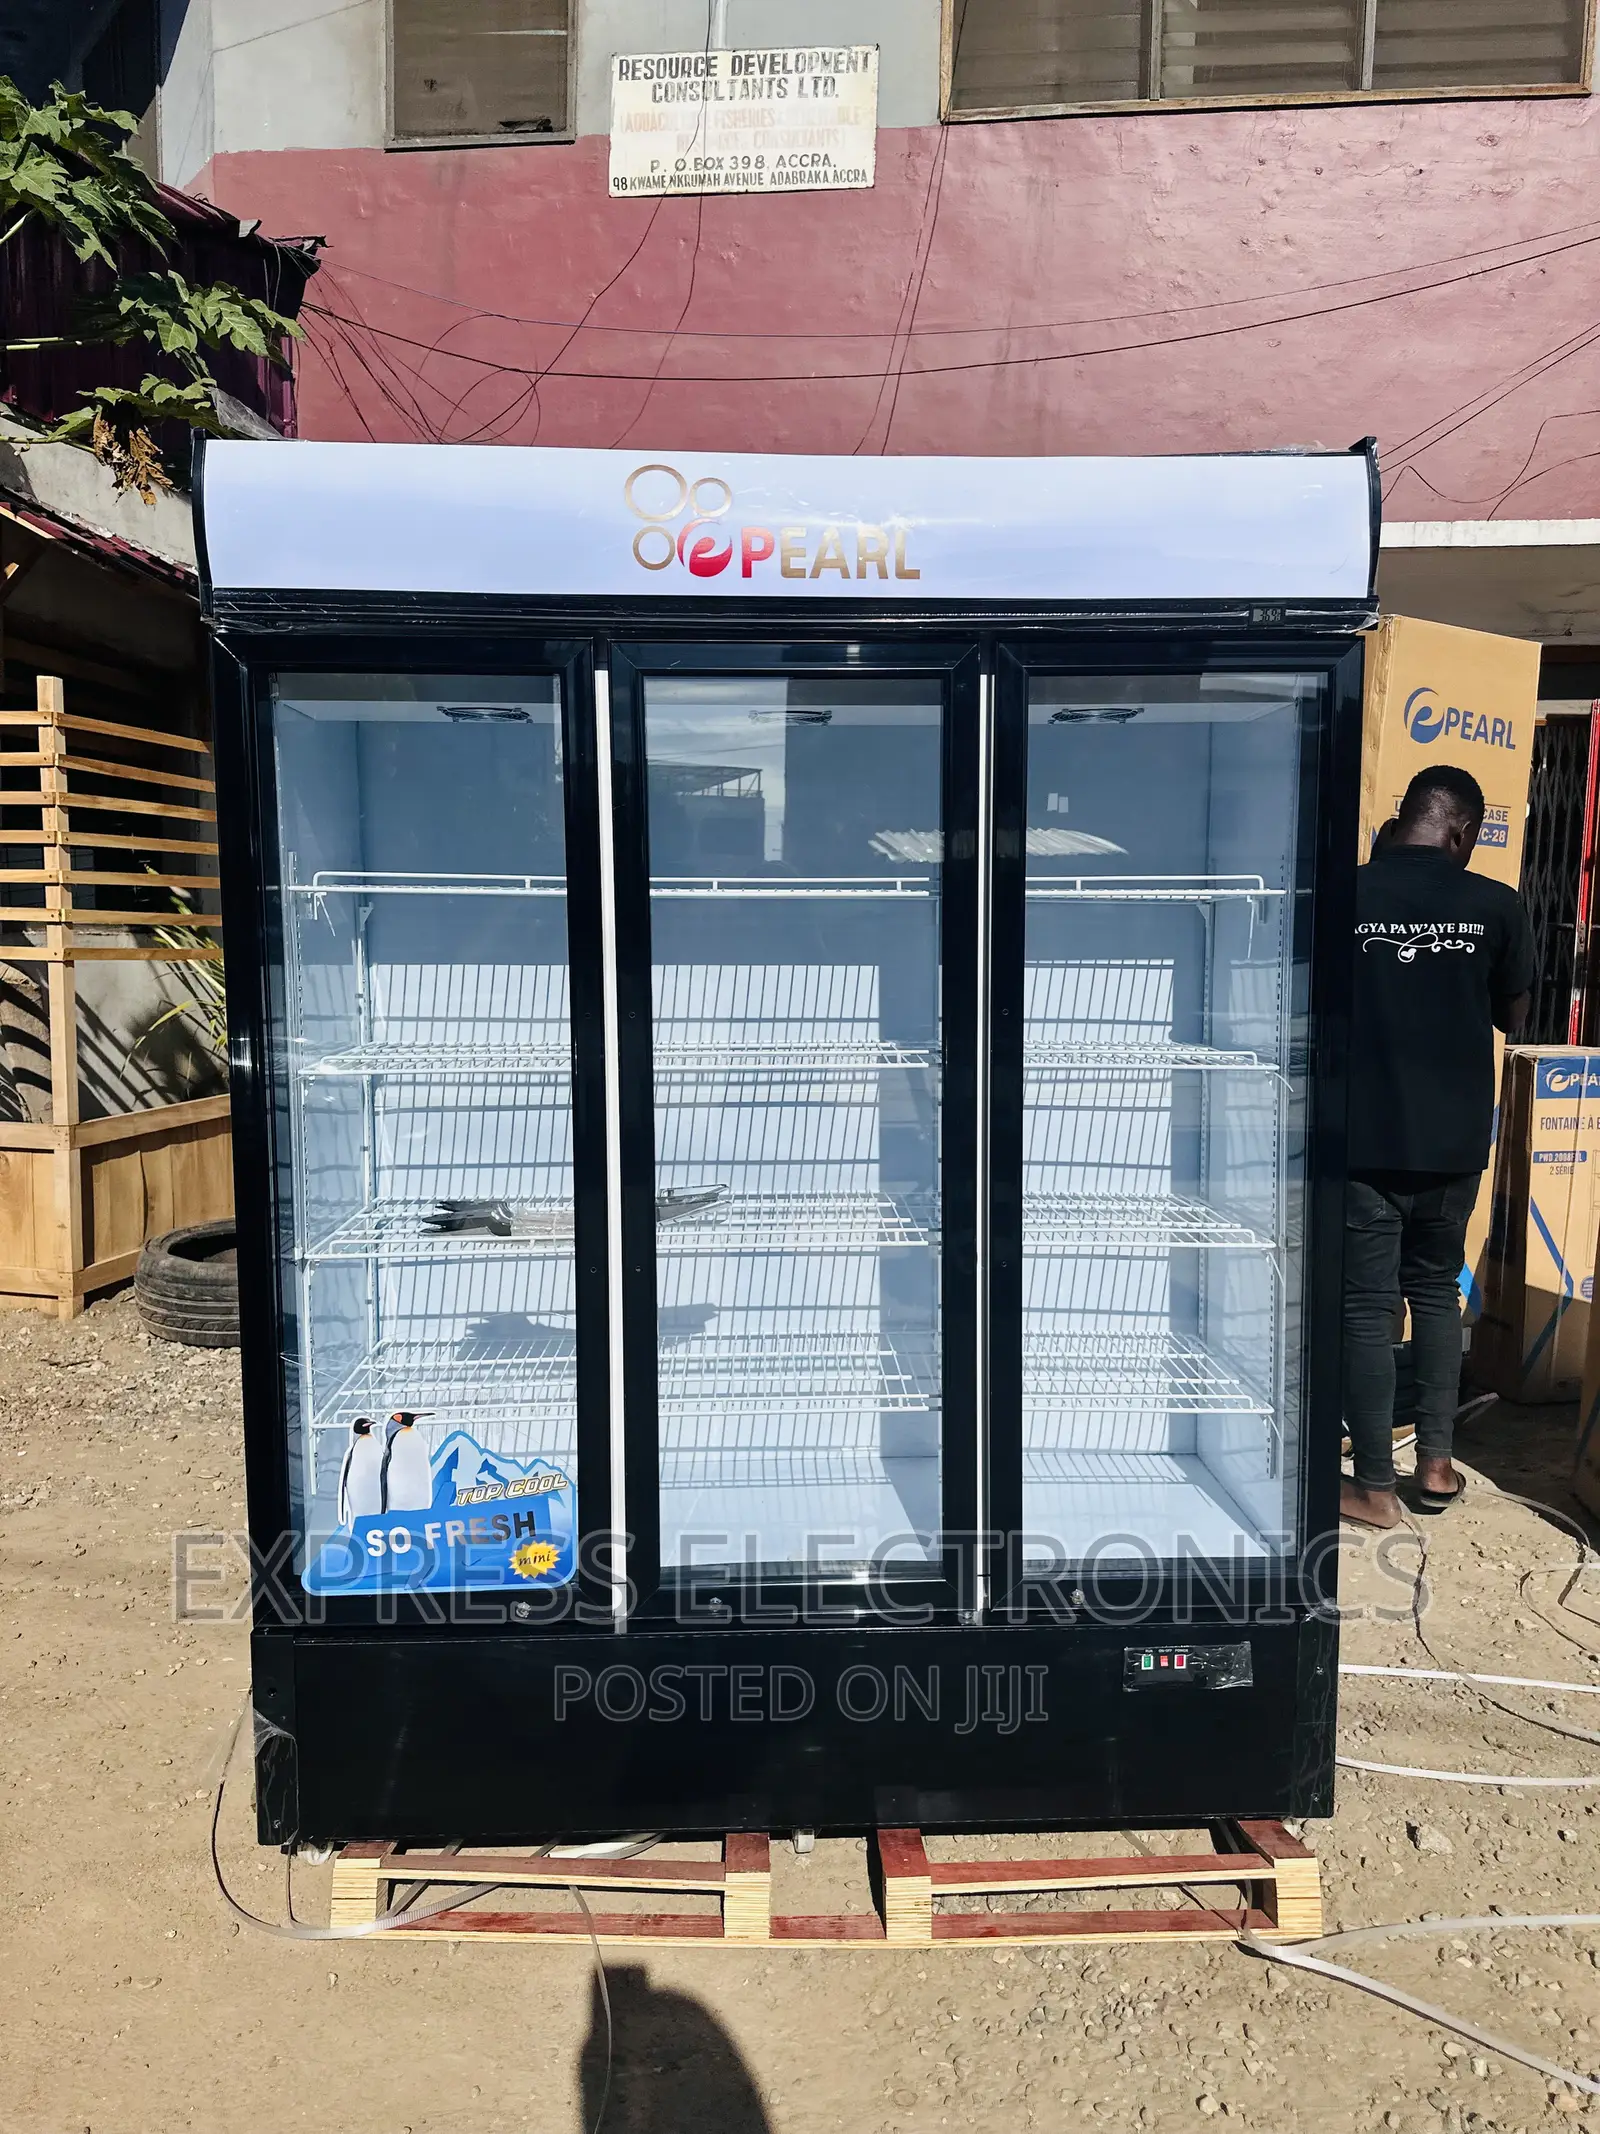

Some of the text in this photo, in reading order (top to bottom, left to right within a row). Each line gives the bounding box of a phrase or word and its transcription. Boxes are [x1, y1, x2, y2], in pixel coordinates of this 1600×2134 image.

[618, 51, 872, 81] RESOURCE DEVELOPMENT
[652, 75, 840, 103] CONSULTANTS LTD.
[775, 153, 837, 168] ACCRA.
[613, 176, 628, 191] 98
[629, 174, 666, 190] KWAME
[669, 173, 721, 188] NKRUMAH
[723, 171, 764, 186] AVENUE
[1444, 706, 1517, 750] PEARL
[1390, 923, 1407, 934] PA
[1458, 922, 1485, 935] BI!!!
[457, 1473, 569, 1506] TOP COOL
[366, 1511, 537, 1556] SO FRESH
[517, 1551, 551, 1567] mini
